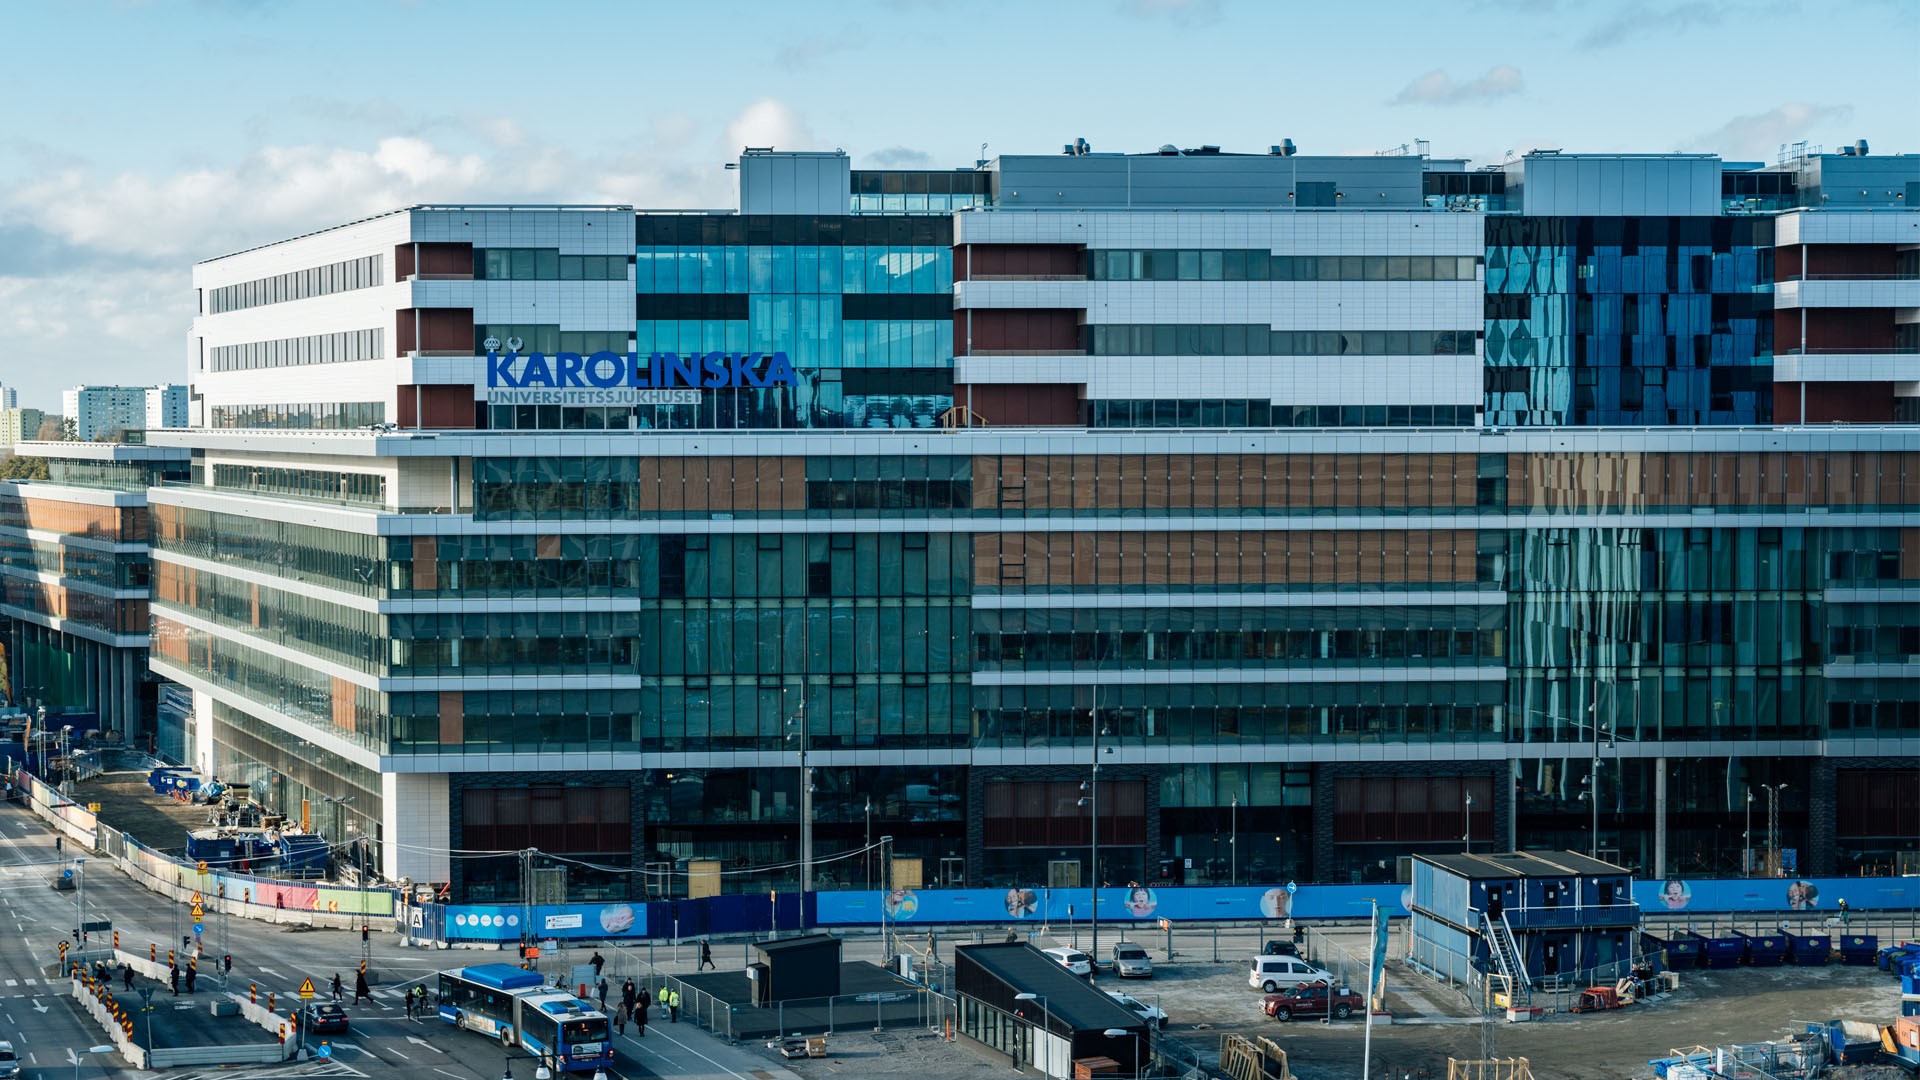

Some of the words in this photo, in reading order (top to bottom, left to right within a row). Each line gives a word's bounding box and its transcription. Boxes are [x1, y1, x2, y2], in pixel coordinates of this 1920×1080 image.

[487, 351, 798, 389] KAROLINSKA
[488, 391, 701, 404] UNIVERSITETSSJUKHUSET
[413, 914, 421, 926] A
